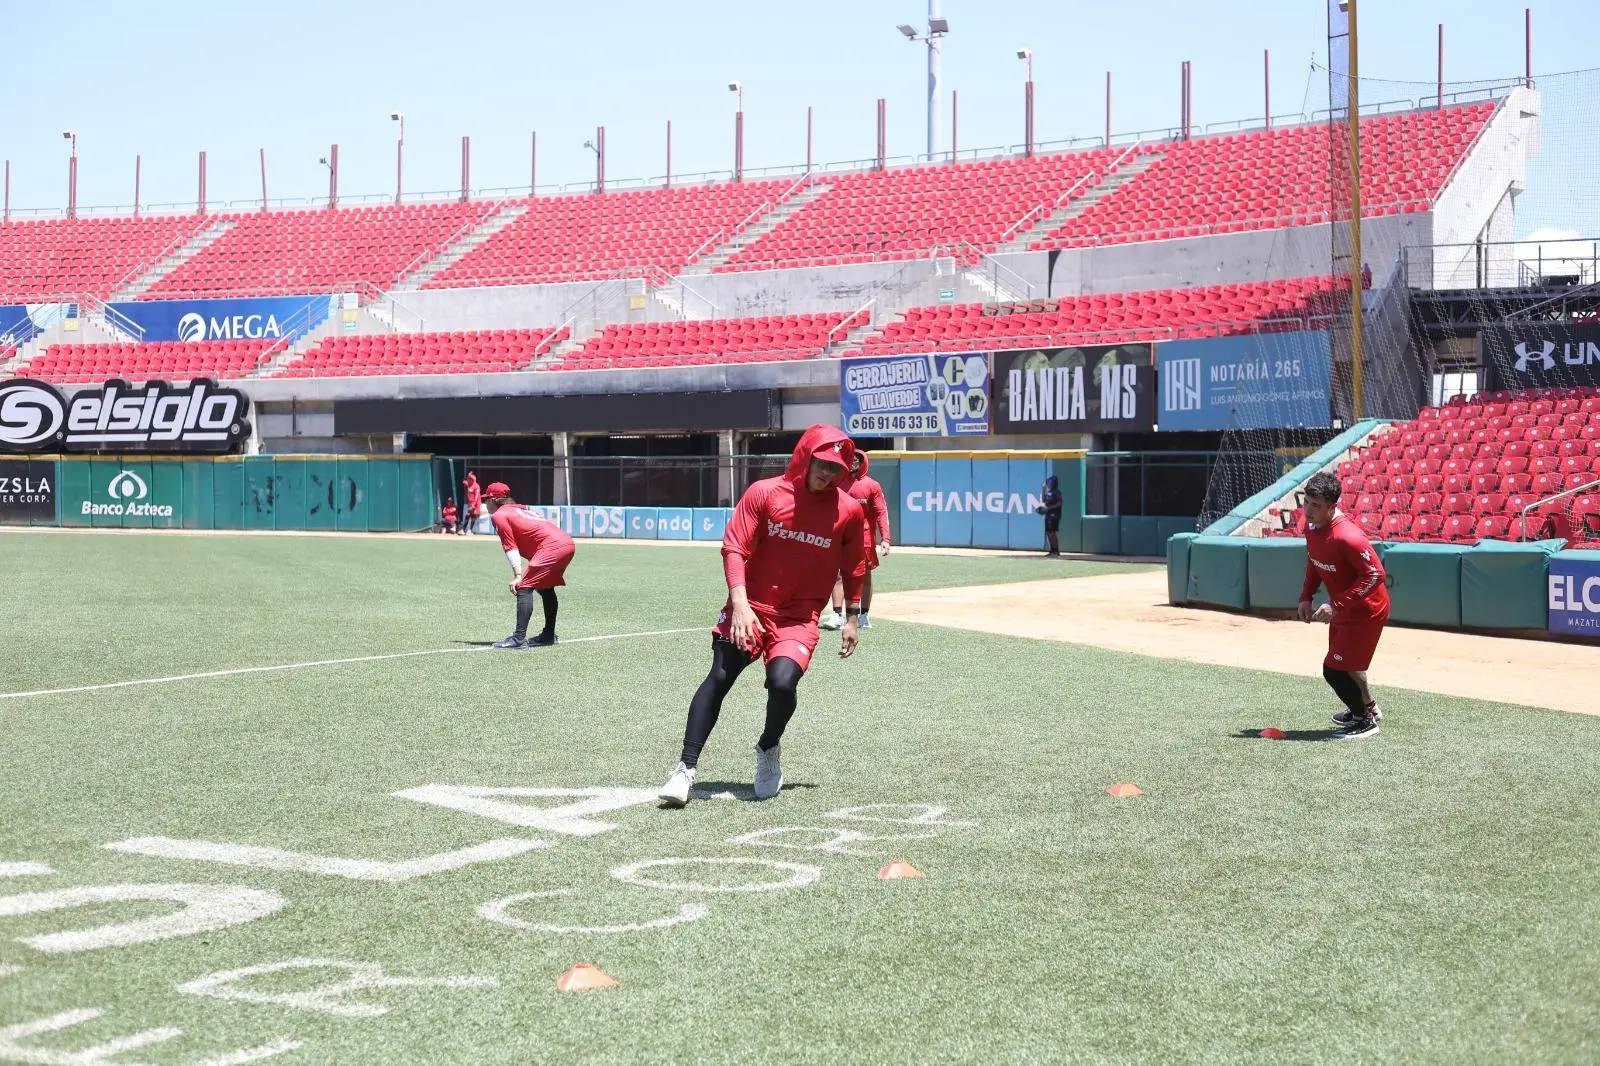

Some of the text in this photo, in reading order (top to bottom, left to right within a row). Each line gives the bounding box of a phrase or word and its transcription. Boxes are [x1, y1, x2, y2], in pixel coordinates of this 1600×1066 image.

[207, 315, 280, 340] MEGA
[847, 360, 927, 391] CERRAJERIA
[1211, 359, 1301, 382] NOTARÍA 265
[861, 388, 920, 411] VILLA VERDE
[1009, 366, 1086, 421] BANDA
[1100, 364, 1137, 419] MS
[67, 384, 238, 441] elsiglo
[20, 495, 50, 503] CORP.
[81, 500, 173, 517] Banco Azteca
[906, 491, 1045, 514] CHANGAN
[704, 517, 715, 532] &
